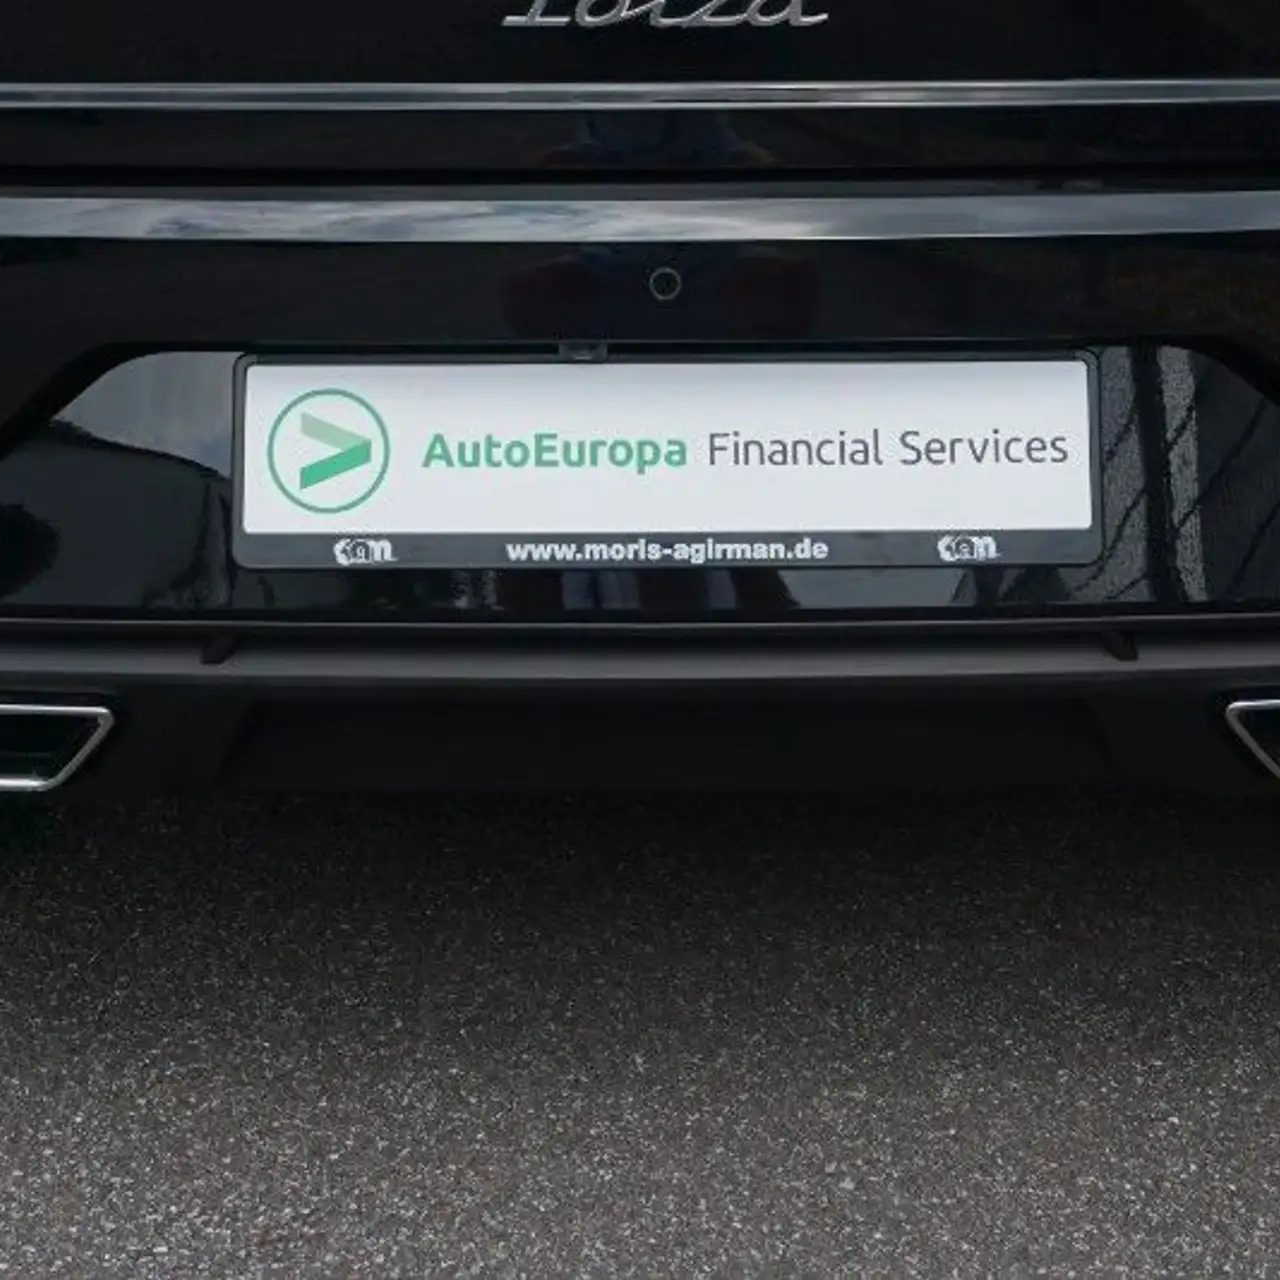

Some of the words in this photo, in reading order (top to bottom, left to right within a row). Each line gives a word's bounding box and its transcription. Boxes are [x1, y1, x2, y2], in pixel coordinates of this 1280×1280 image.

[422, 432, 688, 474] AutoEuropa
[708, 429, 883, 466] Financial
[899, 431, 1069, 465] Services
[505, 537, 829, 564] www.moris-agirman.de
